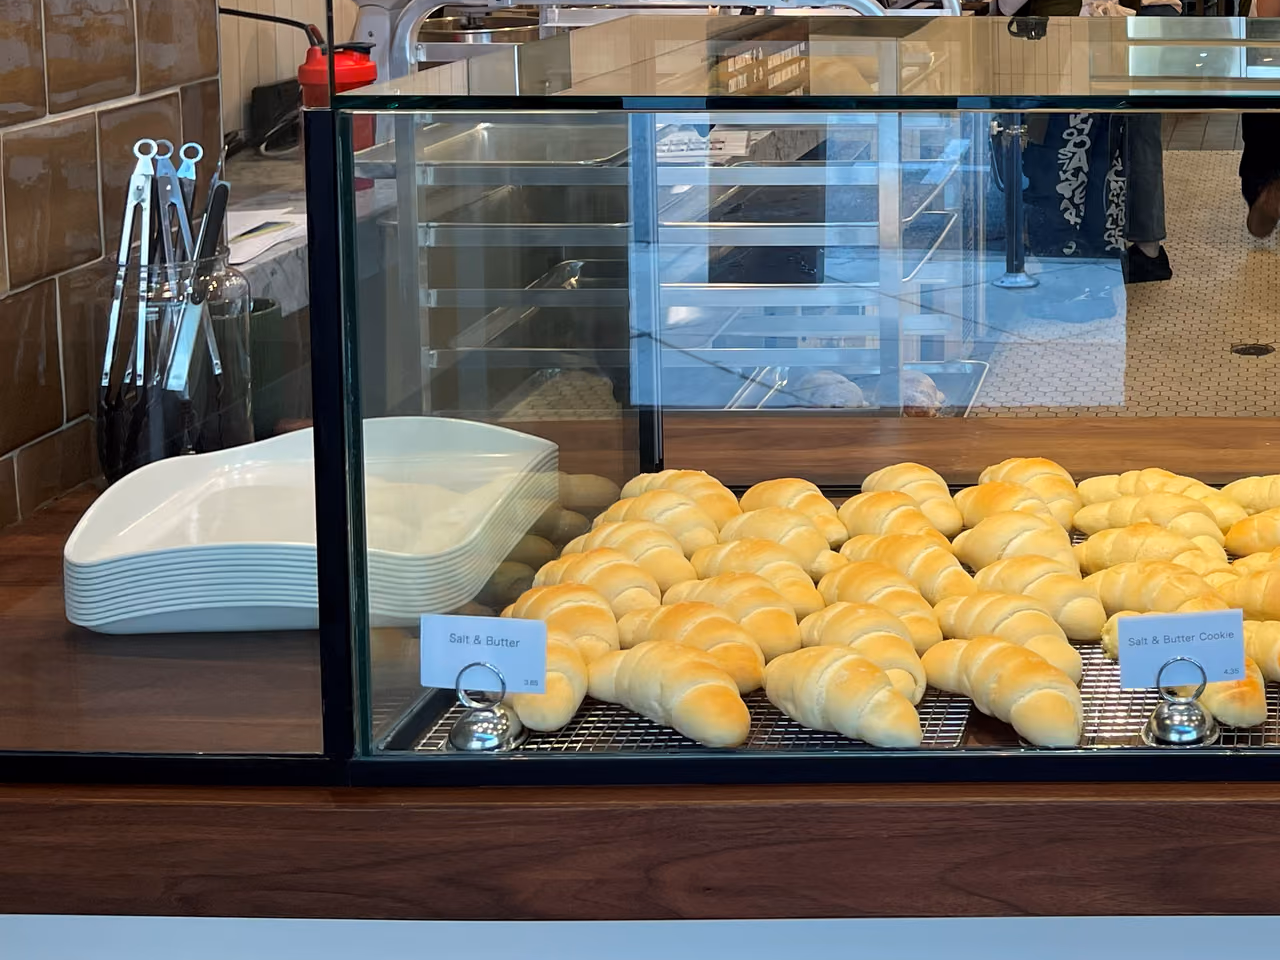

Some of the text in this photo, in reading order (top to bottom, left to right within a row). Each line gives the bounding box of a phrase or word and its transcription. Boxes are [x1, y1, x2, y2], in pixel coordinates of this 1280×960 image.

[449, 633, 520, 648] Salt & Butter
[1128, 630, 1235, 647] Salt & Butter Cookie
[1223, 667, 1240, 675] 4.35
